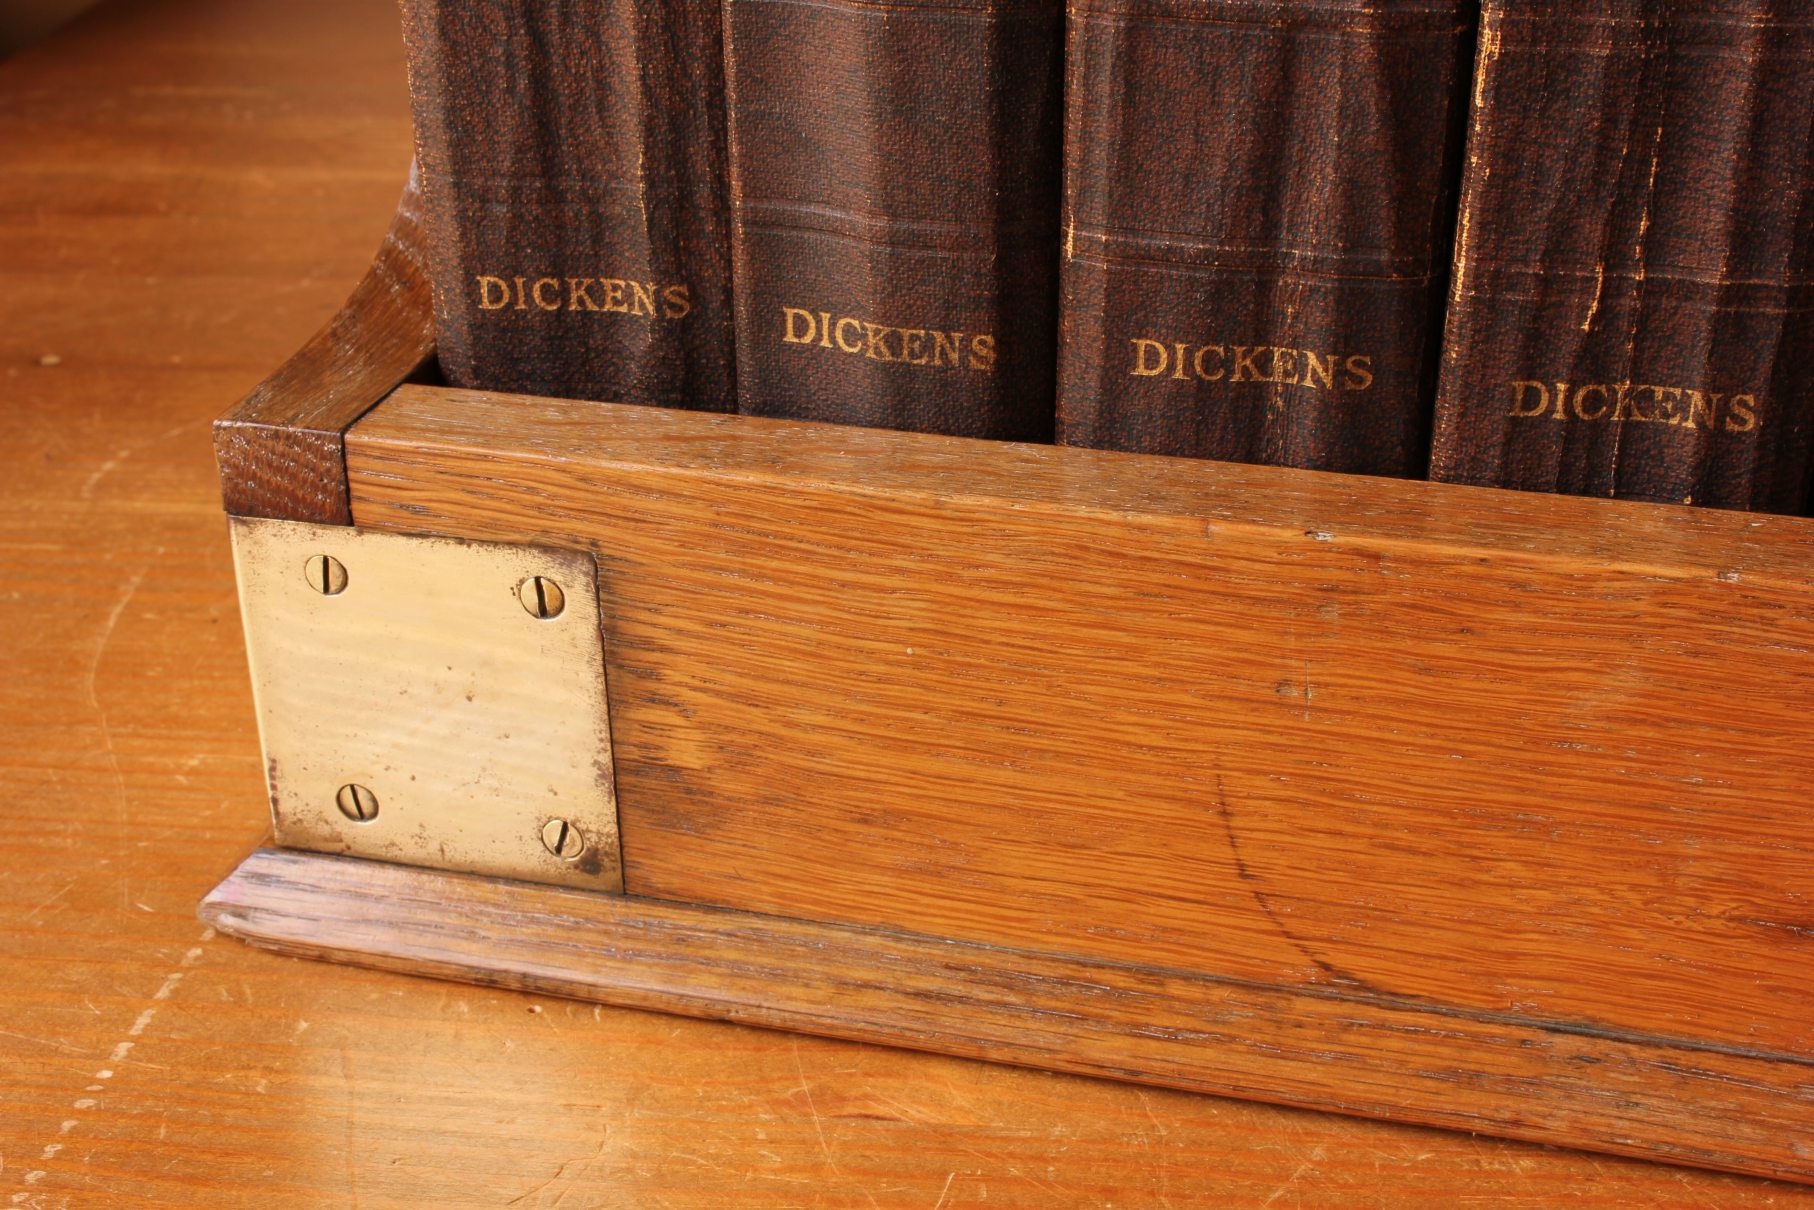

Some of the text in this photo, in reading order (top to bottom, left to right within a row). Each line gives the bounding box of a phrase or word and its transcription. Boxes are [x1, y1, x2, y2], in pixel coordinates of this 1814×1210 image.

[476, 274, 690, 319] DICKENS
[782, 306, 997, 371] DICKENS
[1129, 338, 1373, 391] DICKENS
[1508, 380, 1757, 433] DICKENS
